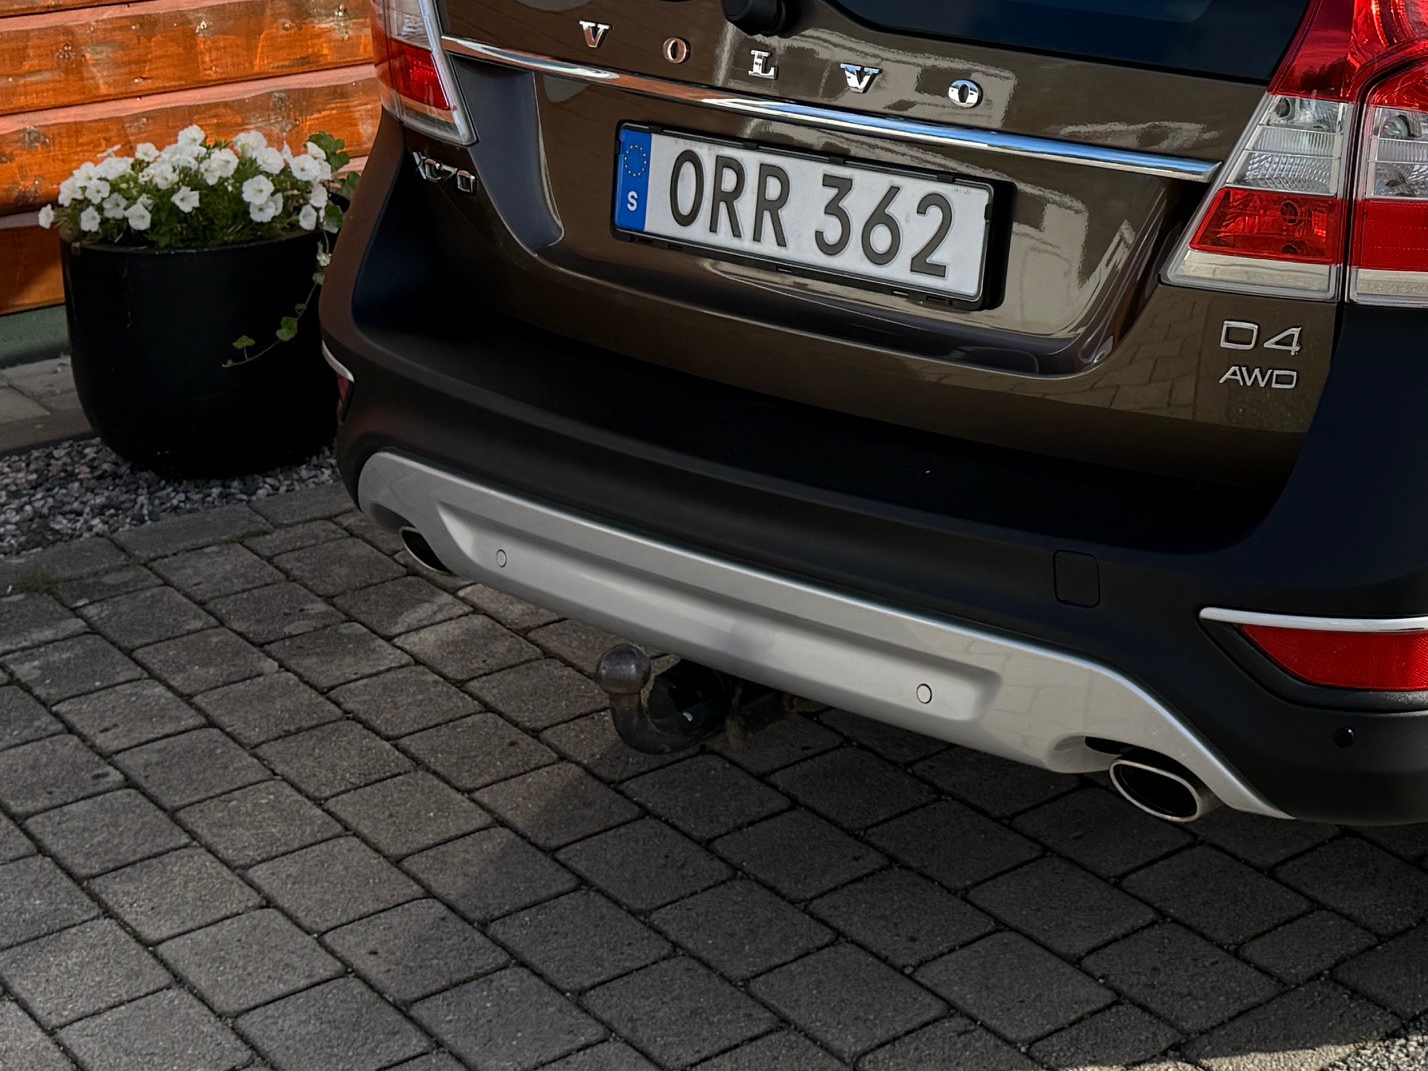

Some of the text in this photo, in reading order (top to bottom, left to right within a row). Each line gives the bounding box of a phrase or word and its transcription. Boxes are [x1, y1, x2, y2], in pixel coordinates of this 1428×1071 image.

[580, 20, 983, 108] VOLVO
[412, 151, 476, 193] XC70
[626, 190, 639, 212] S
[670, 149, 953, 278] ORR 362
[1220, 320, 1302, 356] D4
[1219, 366, 1298, 389] AWD
